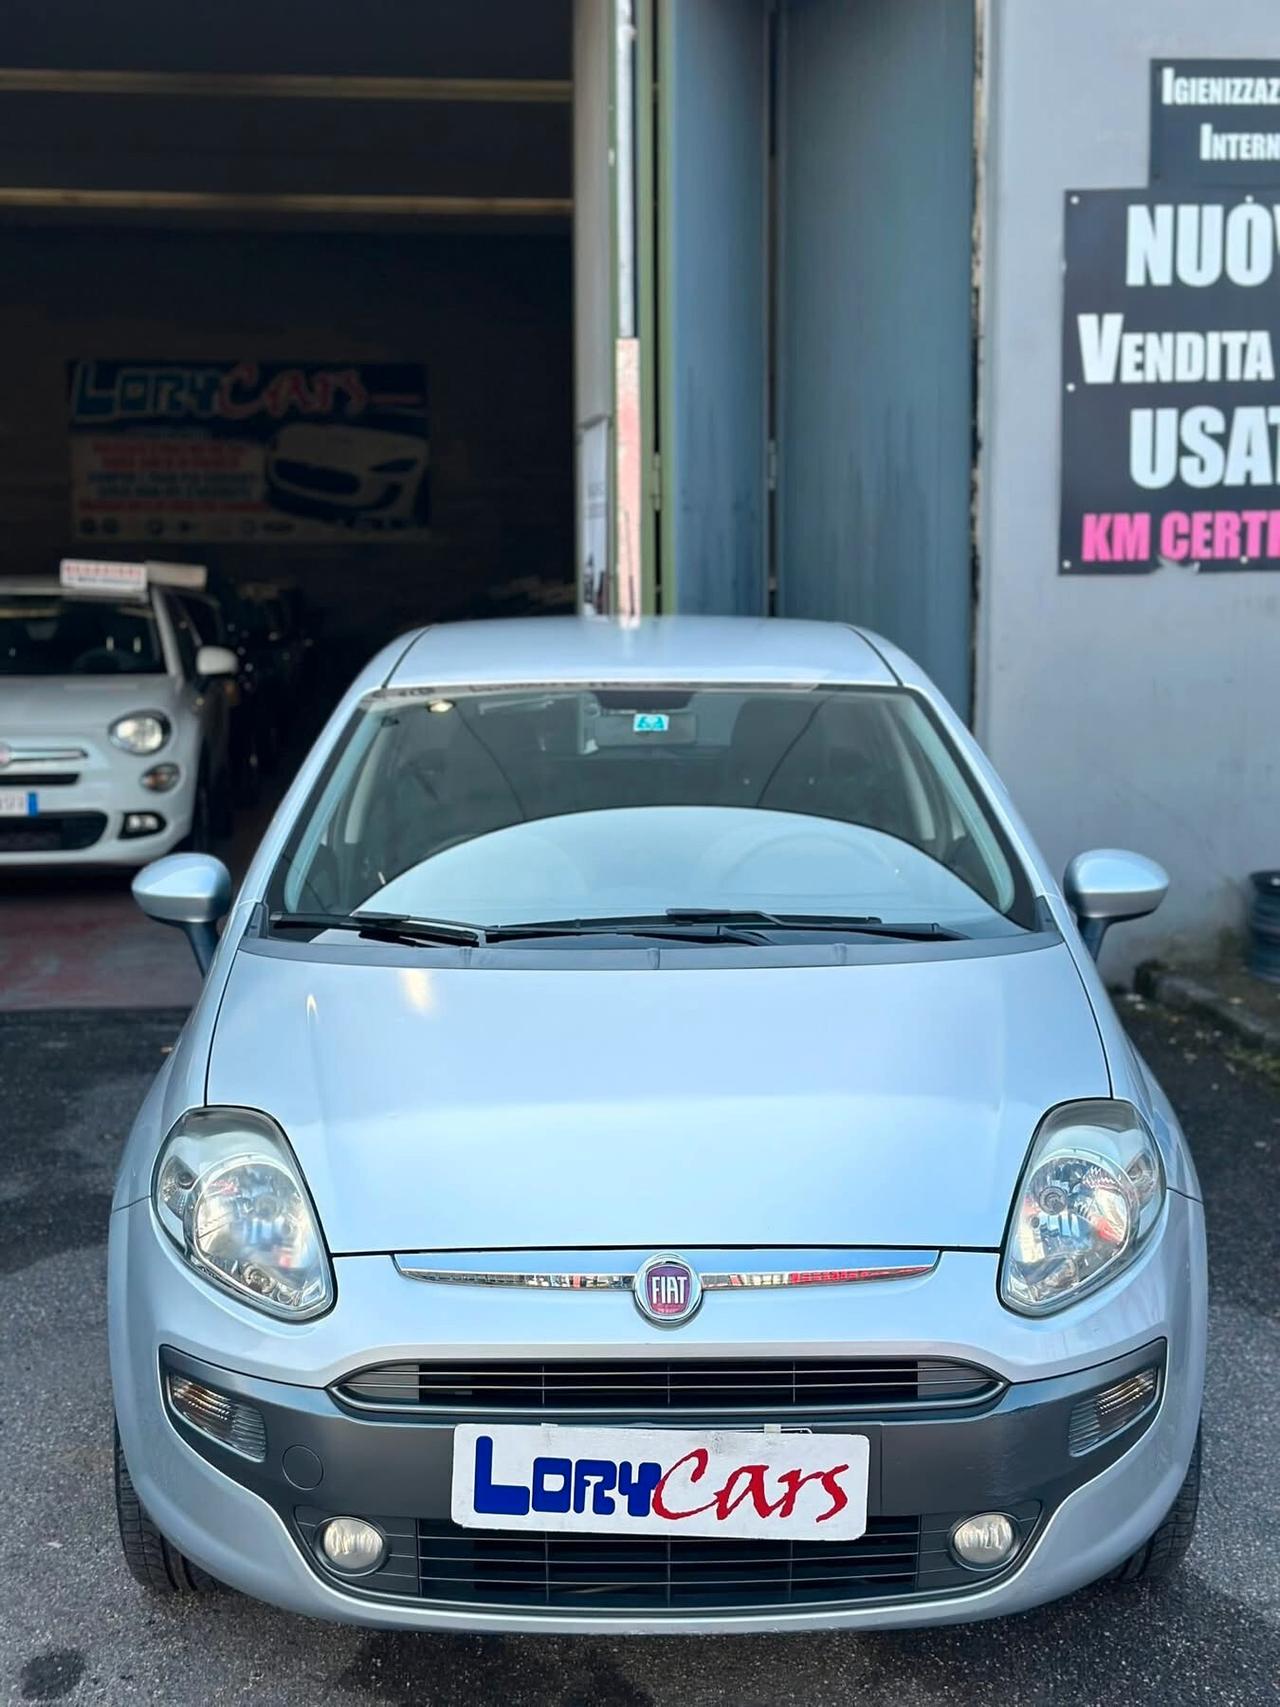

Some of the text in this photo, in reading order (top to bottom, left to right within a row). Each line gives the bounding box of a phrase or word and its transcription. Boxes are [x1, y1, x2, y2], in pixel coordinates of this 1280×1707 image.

[1126, 203, 1280, 287] NUO
[1077, 313, 1274, 384] VENDITA
[1082, 513, 1150, 561] KM
[651, 1276, 688, 1304] FIAT
